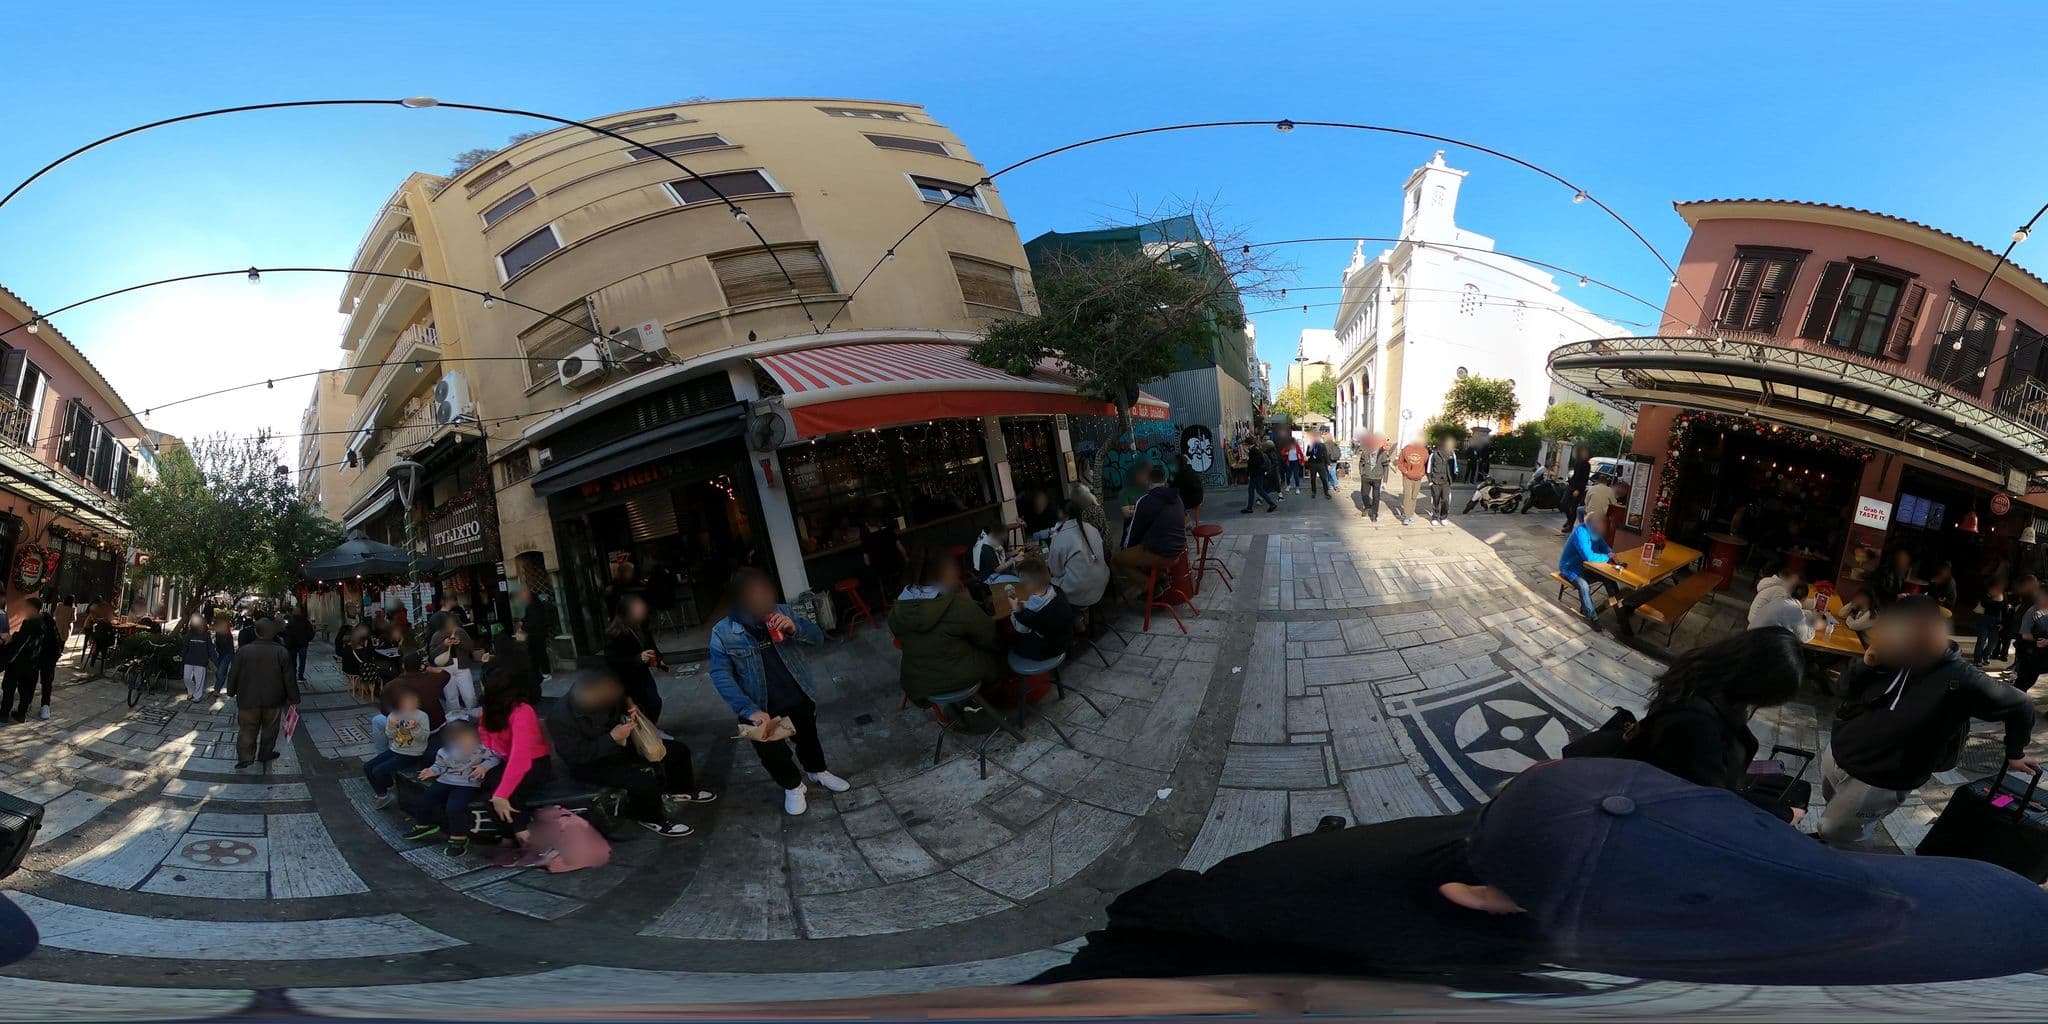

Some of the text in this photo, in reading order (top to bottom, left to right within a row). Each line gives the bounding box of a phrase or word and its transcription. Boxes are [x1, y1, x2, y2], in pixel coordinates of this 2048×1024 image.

[1863, 506, 1878, 514] Grab
[1859, 511, 1878, 520] TASTE
[434, 520, 480, 546] TYLIXTO
